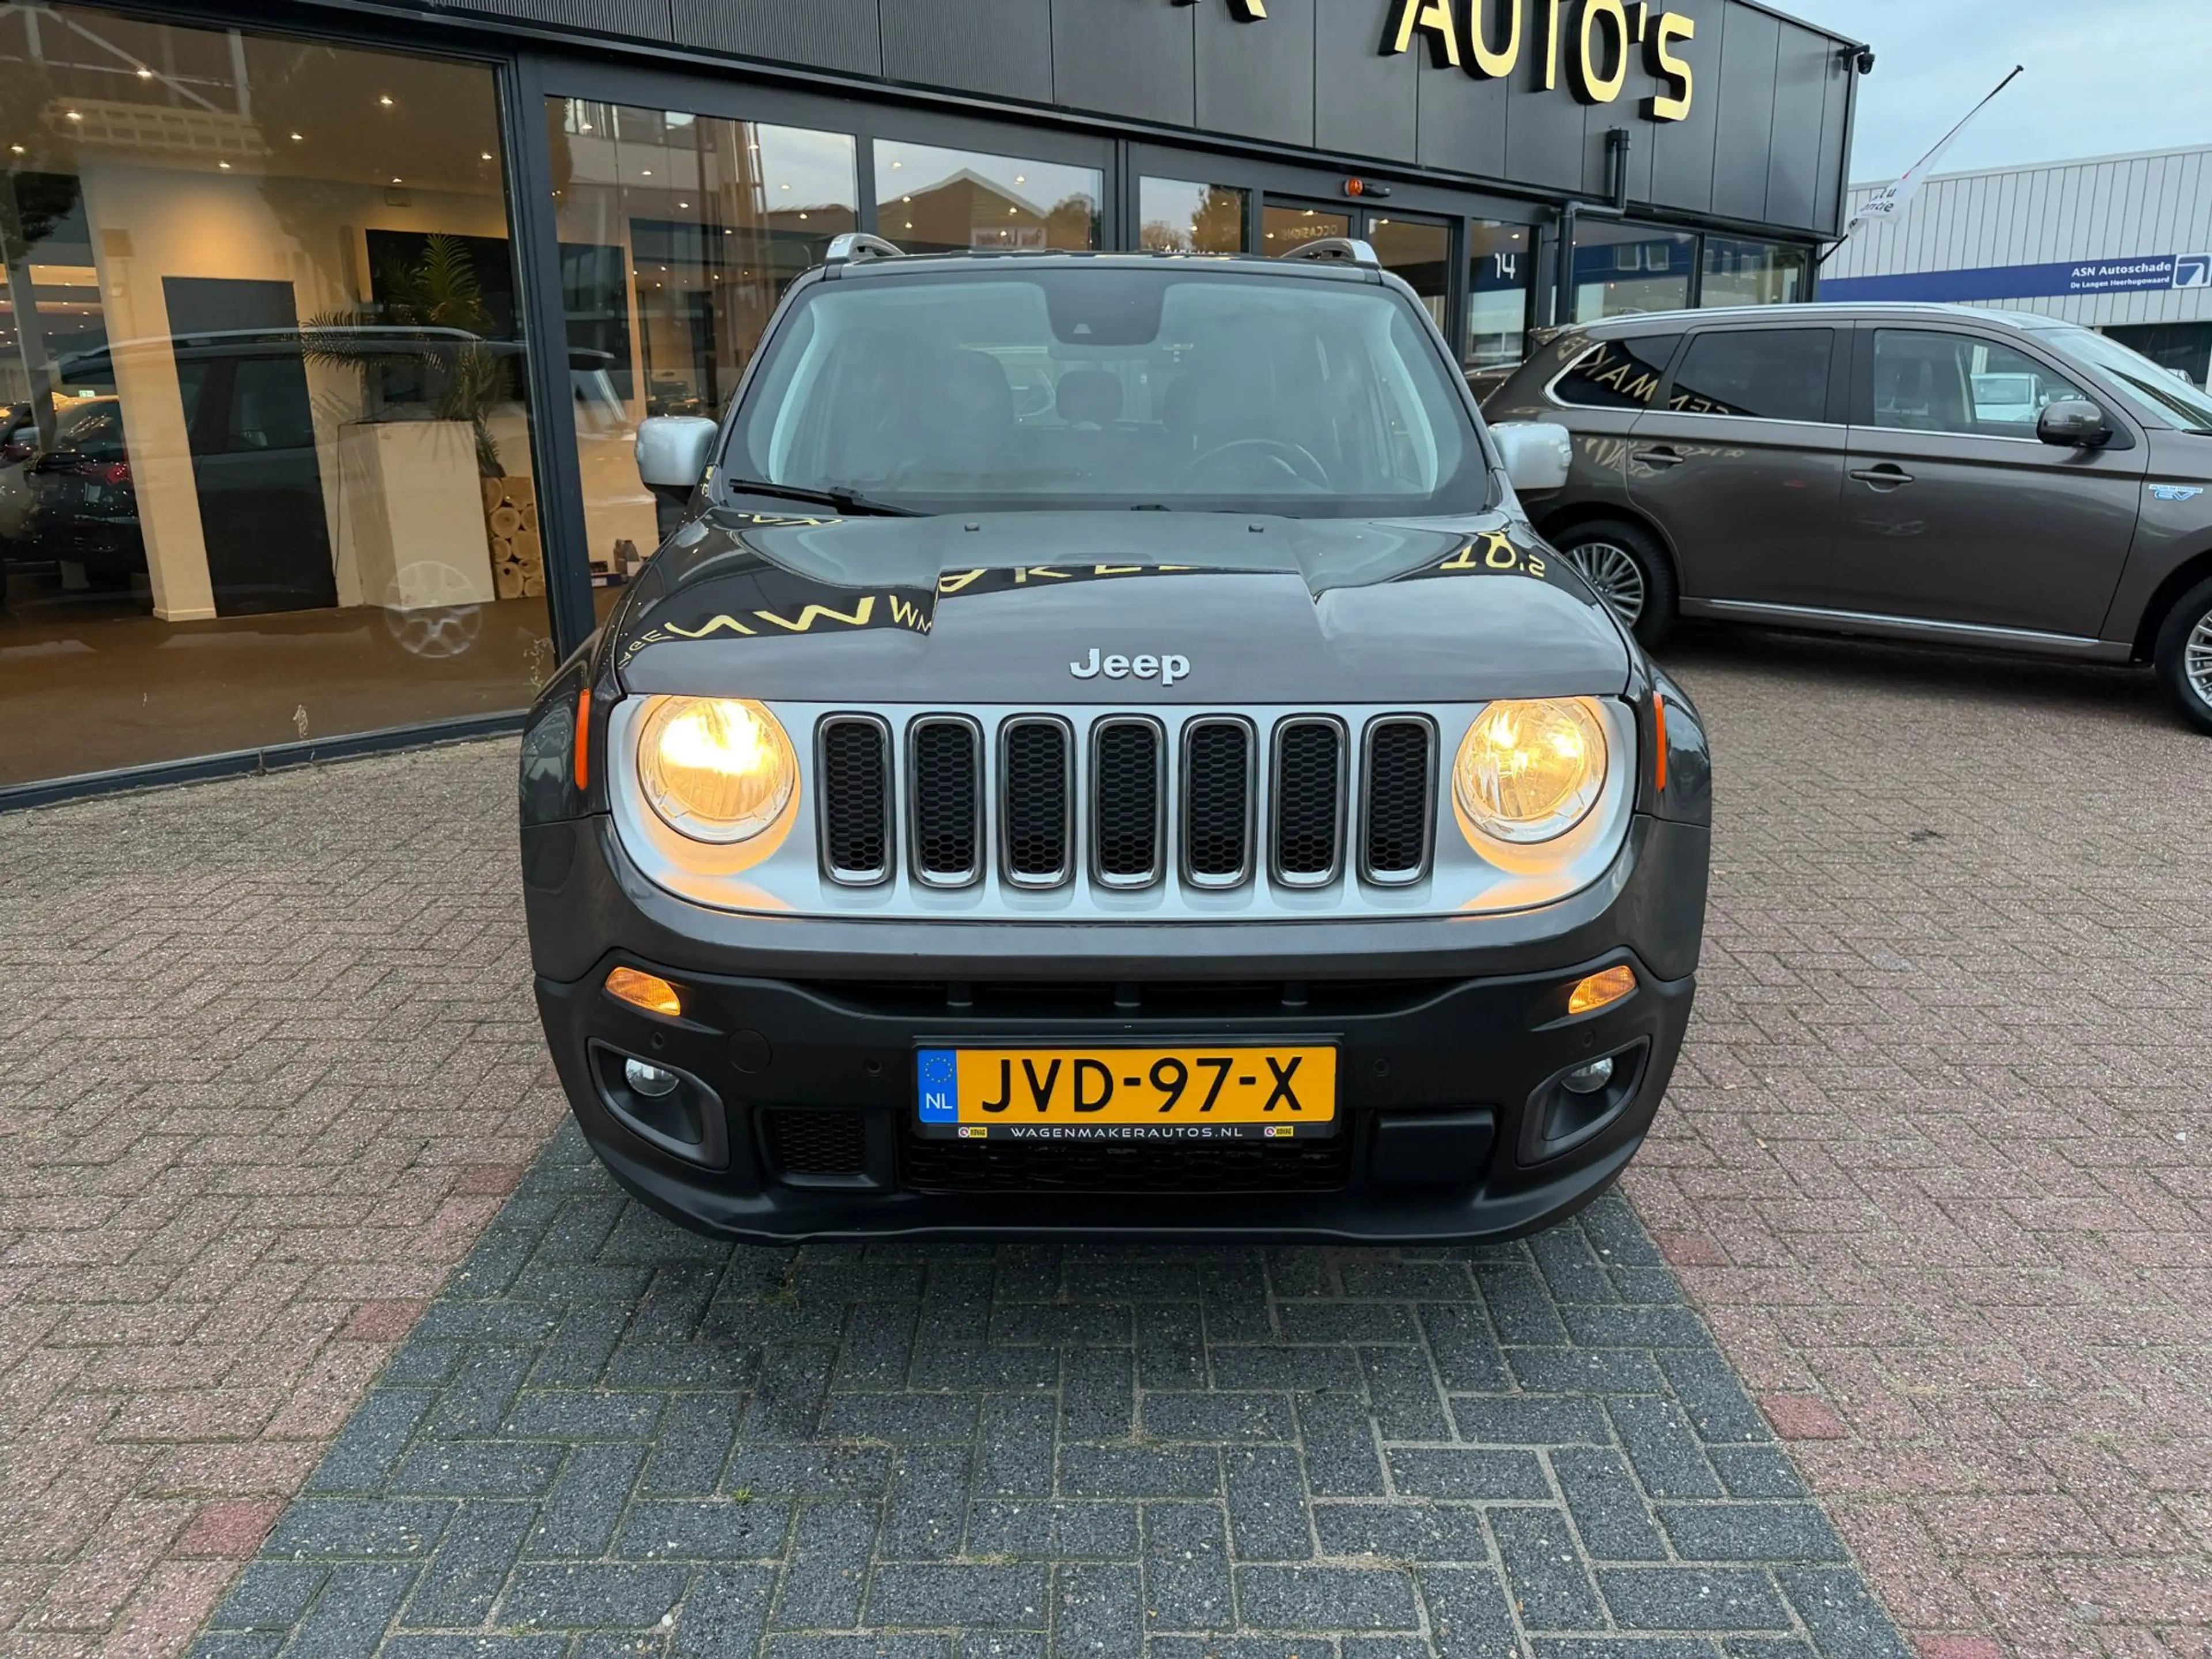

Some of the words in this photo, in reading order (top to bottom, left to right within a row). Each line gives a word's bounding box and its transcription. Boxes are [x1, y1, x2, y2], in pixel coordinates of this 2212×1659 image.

[1494, 252, 1516, 279] 14
[2071, 267, 2096, 277] ASN
[2099, 262, 2172, 275] Autoschade
[1070, 648, 1190, 687] Jeep
[982, 1056, 1302, 1113] JVD-97-X
[926, 1092, 953, 1109] NL
[1010, 1127, 1243, 1138] WAGENMAKERAUTOS.NL
